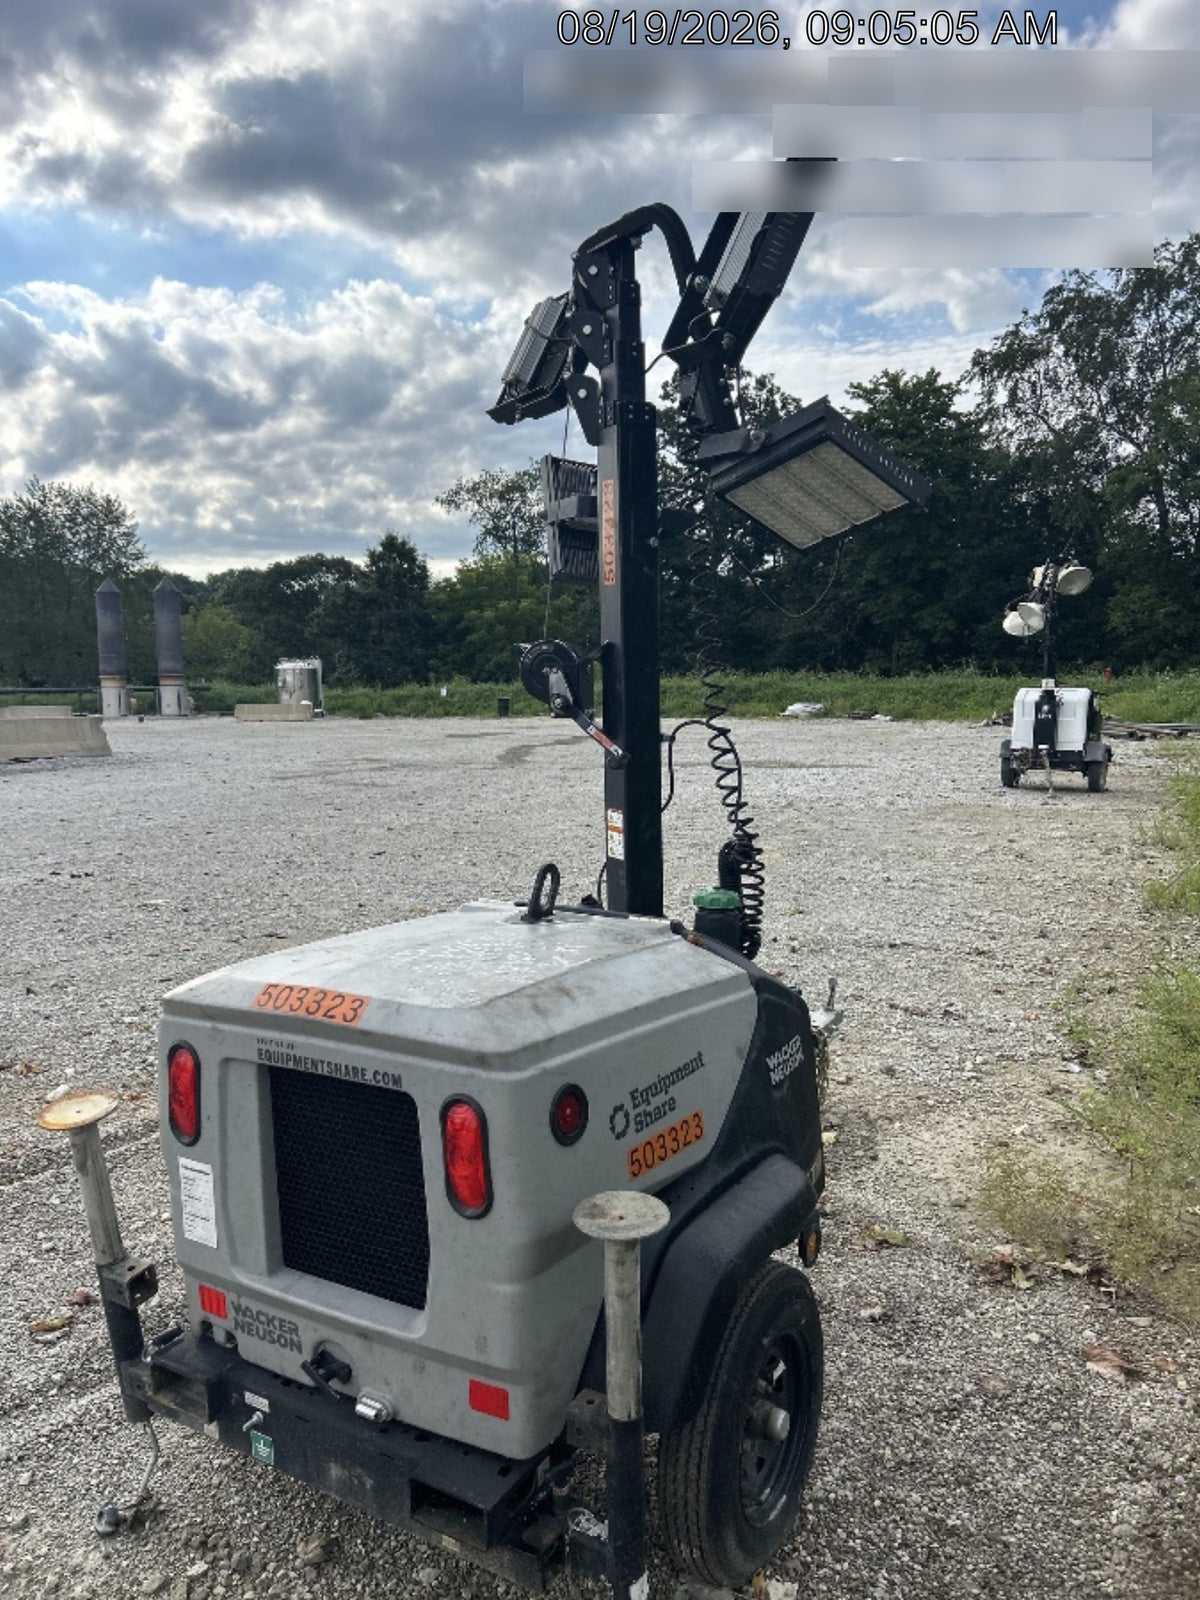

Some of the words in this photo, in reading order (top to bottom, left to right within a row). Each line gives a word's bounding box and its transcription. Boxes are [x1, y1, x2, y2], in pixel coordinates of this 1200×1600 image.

[257, 984, 365, 1023] 503323
[257, 1048, 402, 1089] EQUIPMENTSHARE.COM
[629, 1050, 705, 1109] Equipment
[633, 1096, 676, 1134] Share
[630, 1112, 703, 1177] 503323
[233, 1316, 303, 1355] NEUSON
